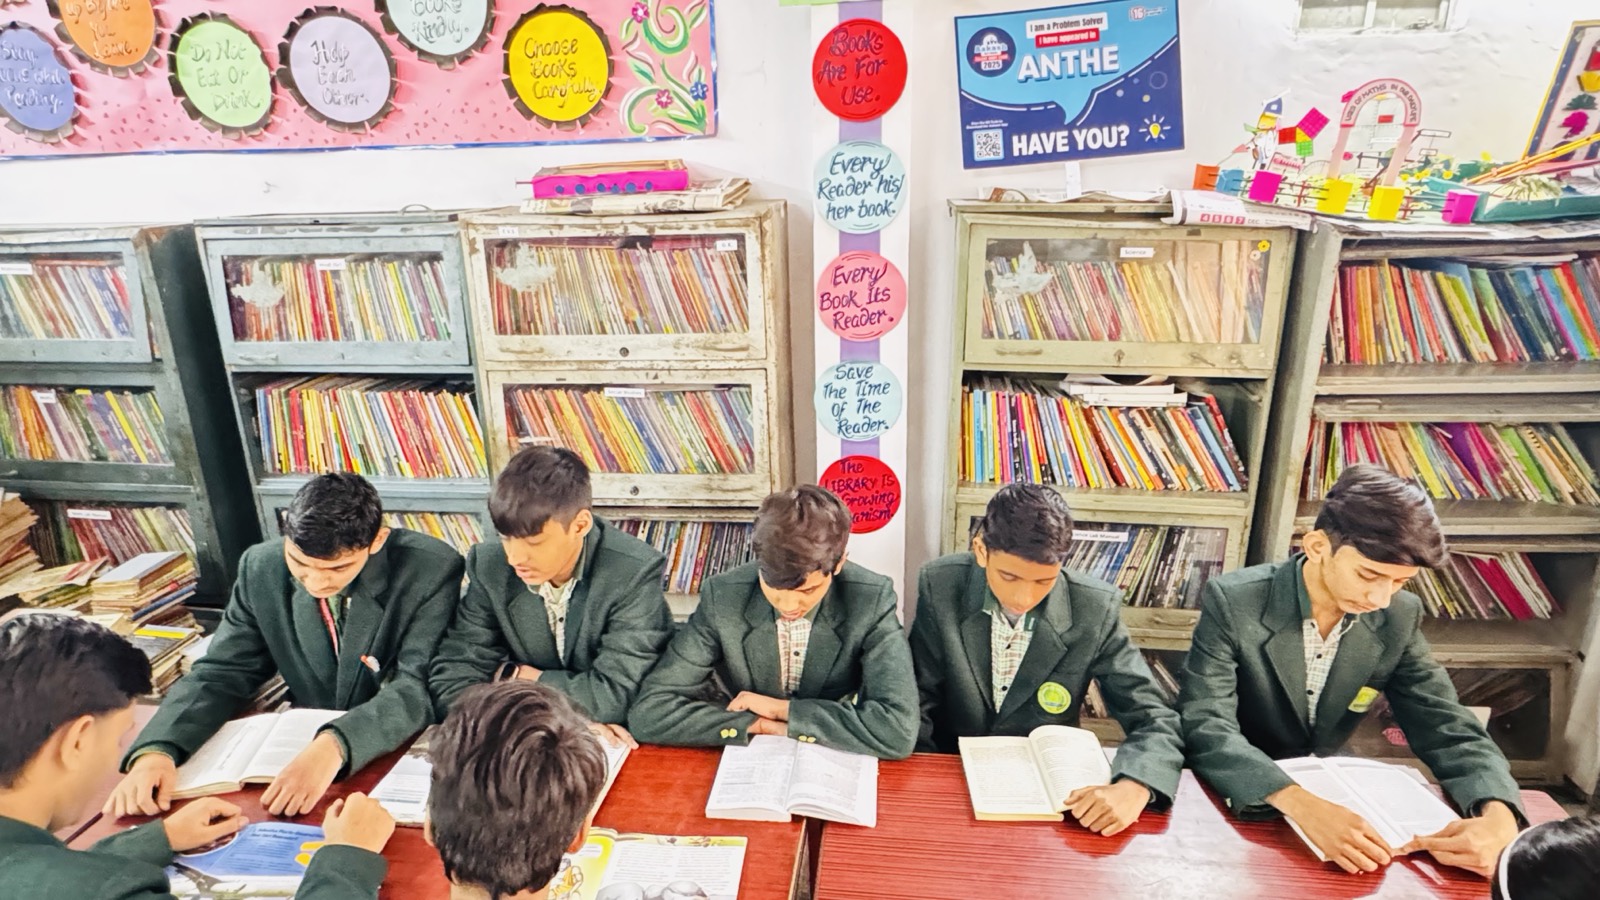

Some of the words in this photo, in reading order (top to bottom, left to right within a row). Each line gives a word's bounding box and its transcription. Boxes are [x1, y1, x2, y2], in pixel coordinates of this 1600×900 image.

[1034, 24, 1045, 32] am
[1052, 19, 1081, 30] Problem
[1082, 17, 1104, 26] Solver
[830, 27, 884, 57] Books
[1059, 31, 1089, 43] appeared
[523, 37, 578, 59] Choose
[817, 60, 847, 88] Are
[855, 54, 888, 80] For
[983, 61, 1001, 69] 2025
[1017, 45, 1120, 83] ANTHE
[841, 85, 881, 106] Use.
[1362, 84, 1387, 98] MATHS
[1012, 129, 1069, 157] HAVE
[1072, 125, 1130, 150] YOU?
[829, 151, 892, 180] Every
[817, 177, 873, 201] Reader
[826, 201, 855, 221] her
[857, 198, 896, 219] book.
[831, 262, 887, 287] Every
[820, 290, 861, 313] Book
[832, 307, 895, 331] Reader.
[835, 363, 874, 381] Save
[823, 382, 847, 400] The
[855, 380, 891, 397] Time
[856, 398, 881, 415] The
[837, 418, 890, 439] Reader.
[840, 458, 865, 475] The
[881, 474, 896, 490] IS
